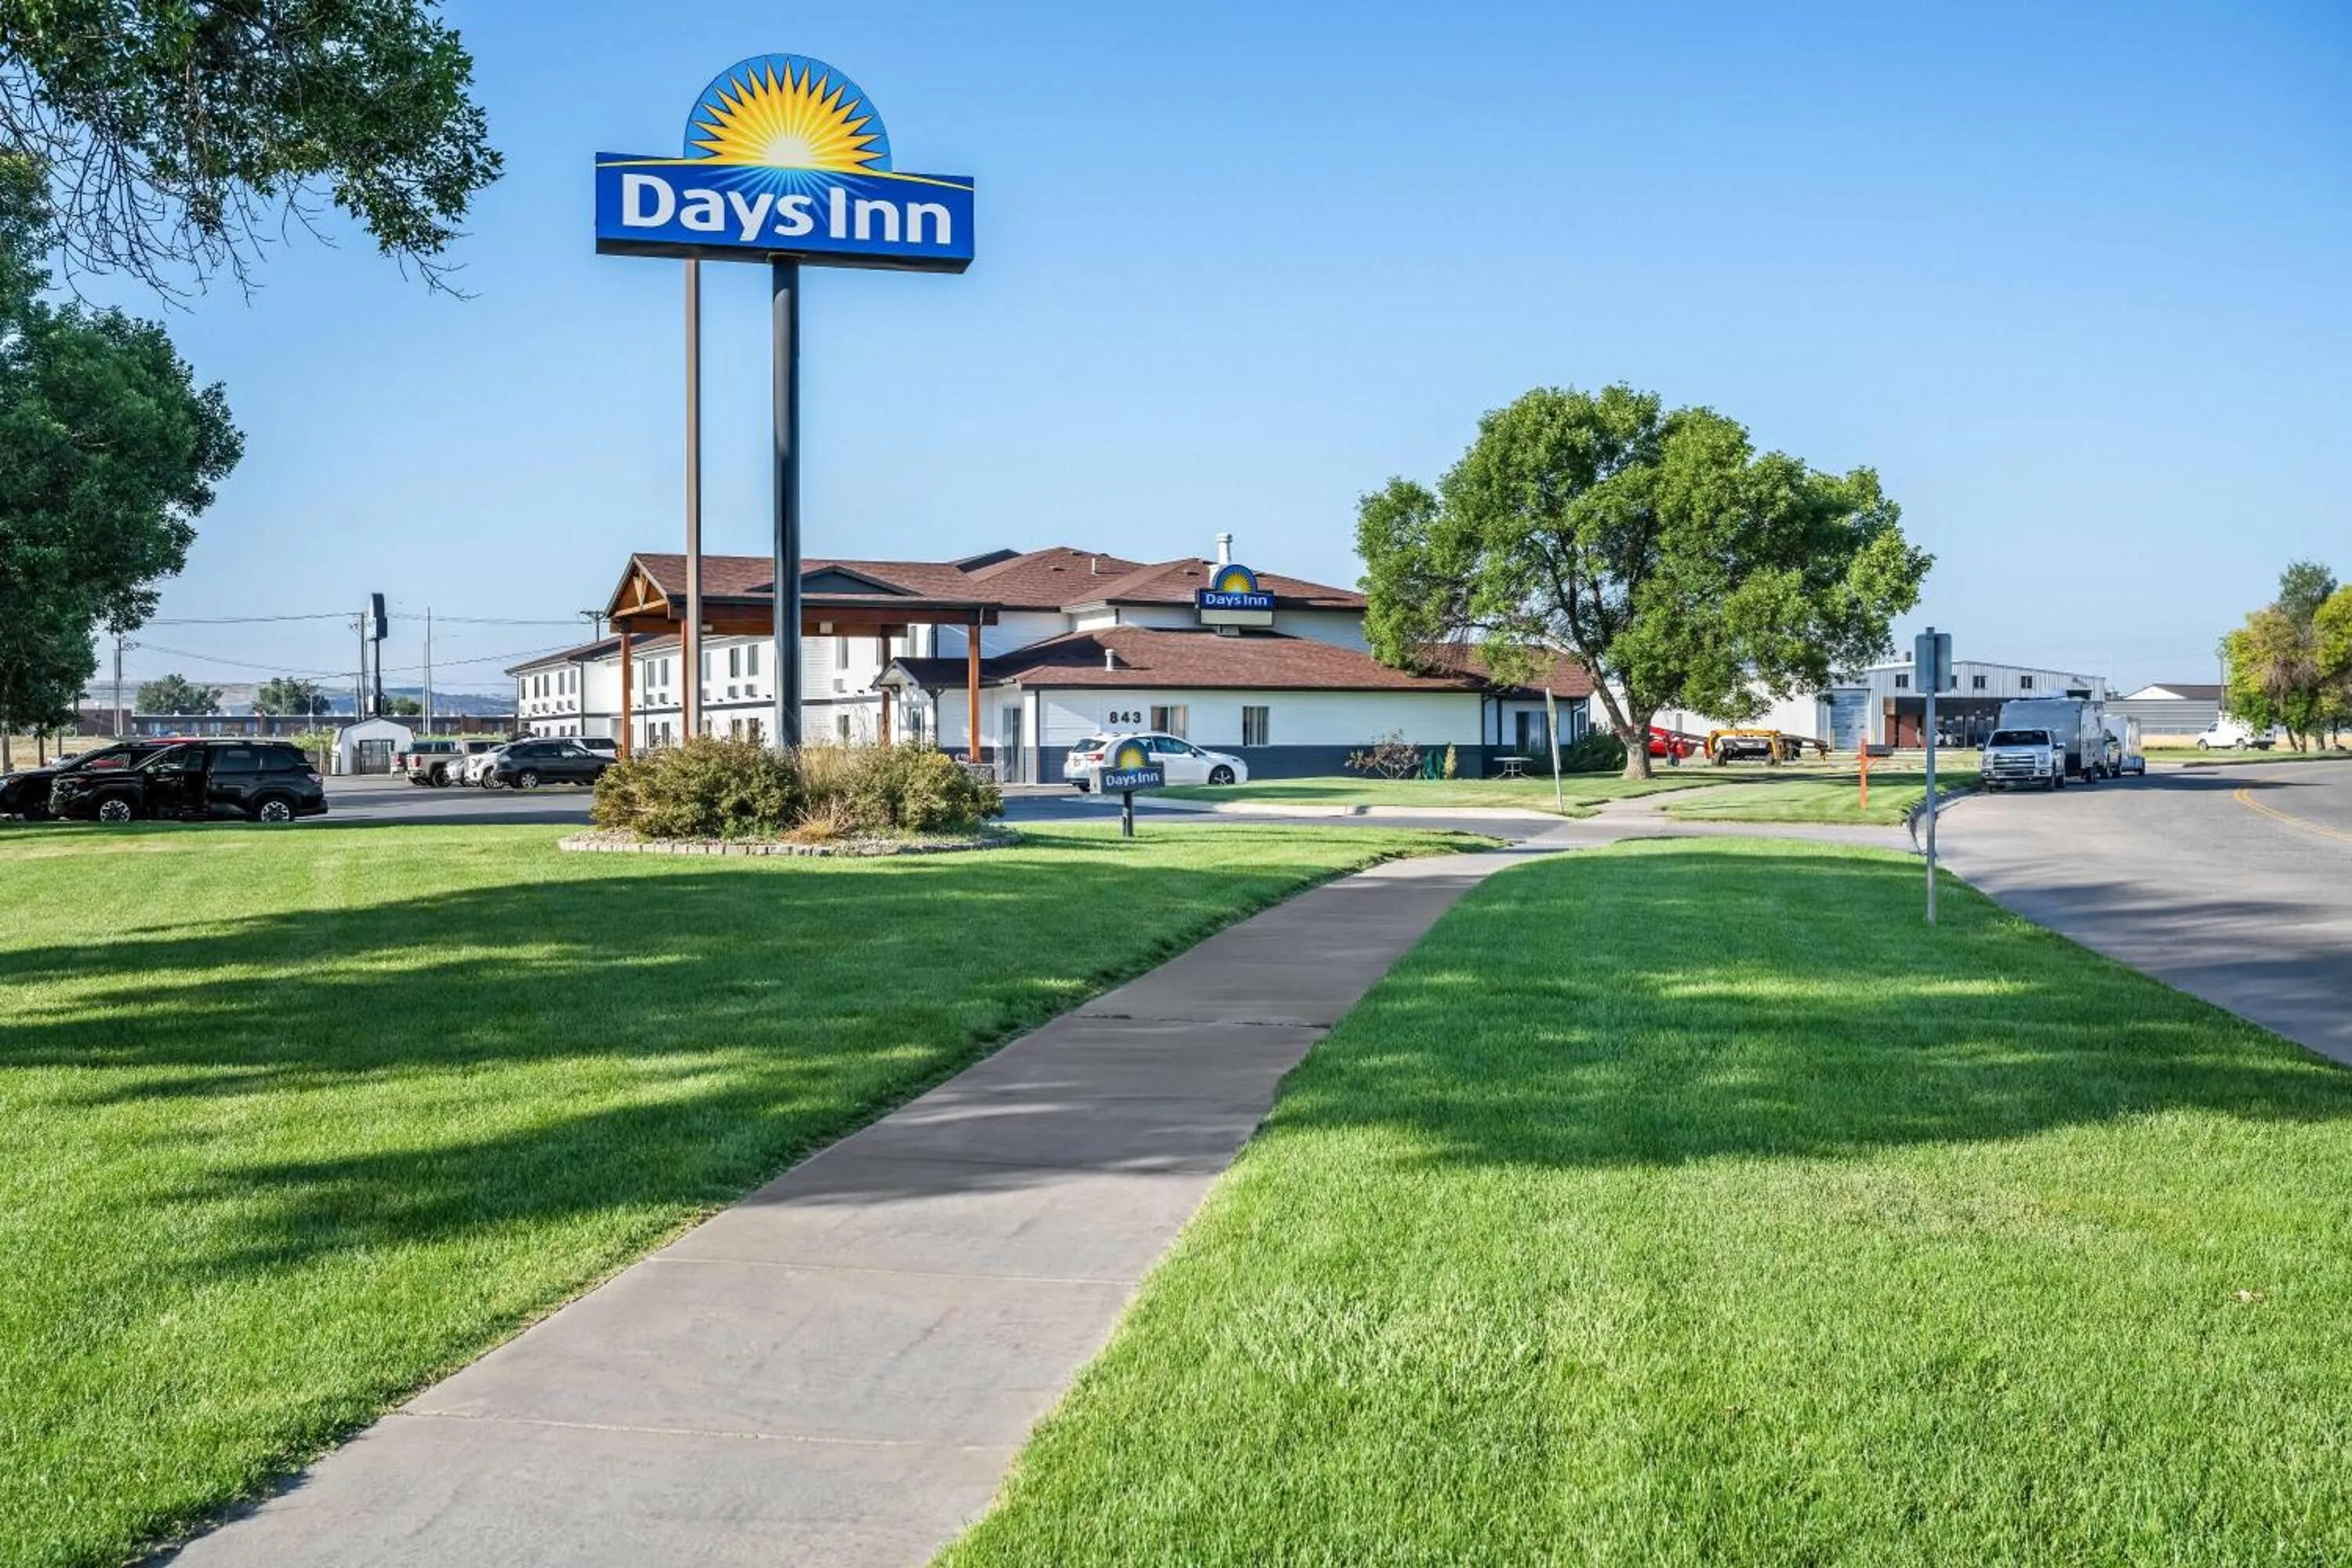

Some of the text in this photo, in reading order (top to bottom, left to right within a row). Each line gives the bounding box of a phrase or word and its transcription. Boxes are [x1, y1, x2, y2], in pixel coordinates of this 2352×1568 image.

[622, 173, 951, 244] Days Inn
[1206, 593, 1268, 606] Days Inn
[1109, 711, 1142, 724] 843
[1106, 772, 1159, 786] Days Inn
